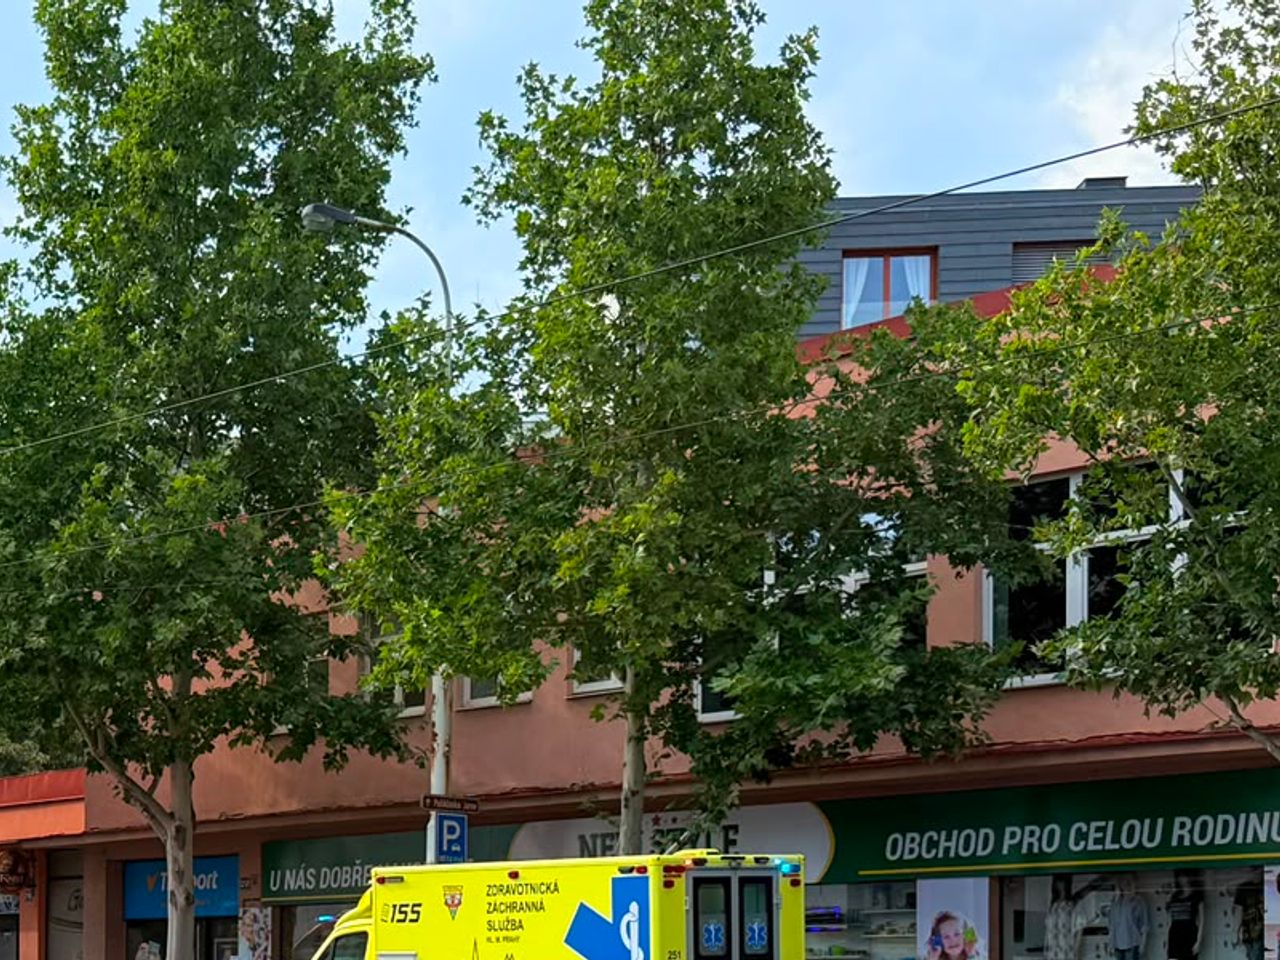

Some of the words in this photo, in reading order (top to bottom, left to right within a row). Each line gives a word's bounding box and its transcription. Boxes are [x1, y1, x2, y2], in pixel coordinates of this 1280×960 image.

[443, 820, 460, 850] P
[577, 831, 620, 857] NE
[885, 828, 995, 861] OBCHOD
[1002, 823, 1061, 855] PRO
[1069, 817, 1163, 852] CELOU
[270, 869, 281, 891] U
[284, 863, 316, 891] NÁS
[486, 879, 560, 897] ZDRAVOTNICKÁ
[390, 902, 422, 923] 155
[486, 900, 546, 914] ZÁCHRANNÁ
[486, 918, 524, 932] SLUŽBA
[668, 951, 681, 960] 251
